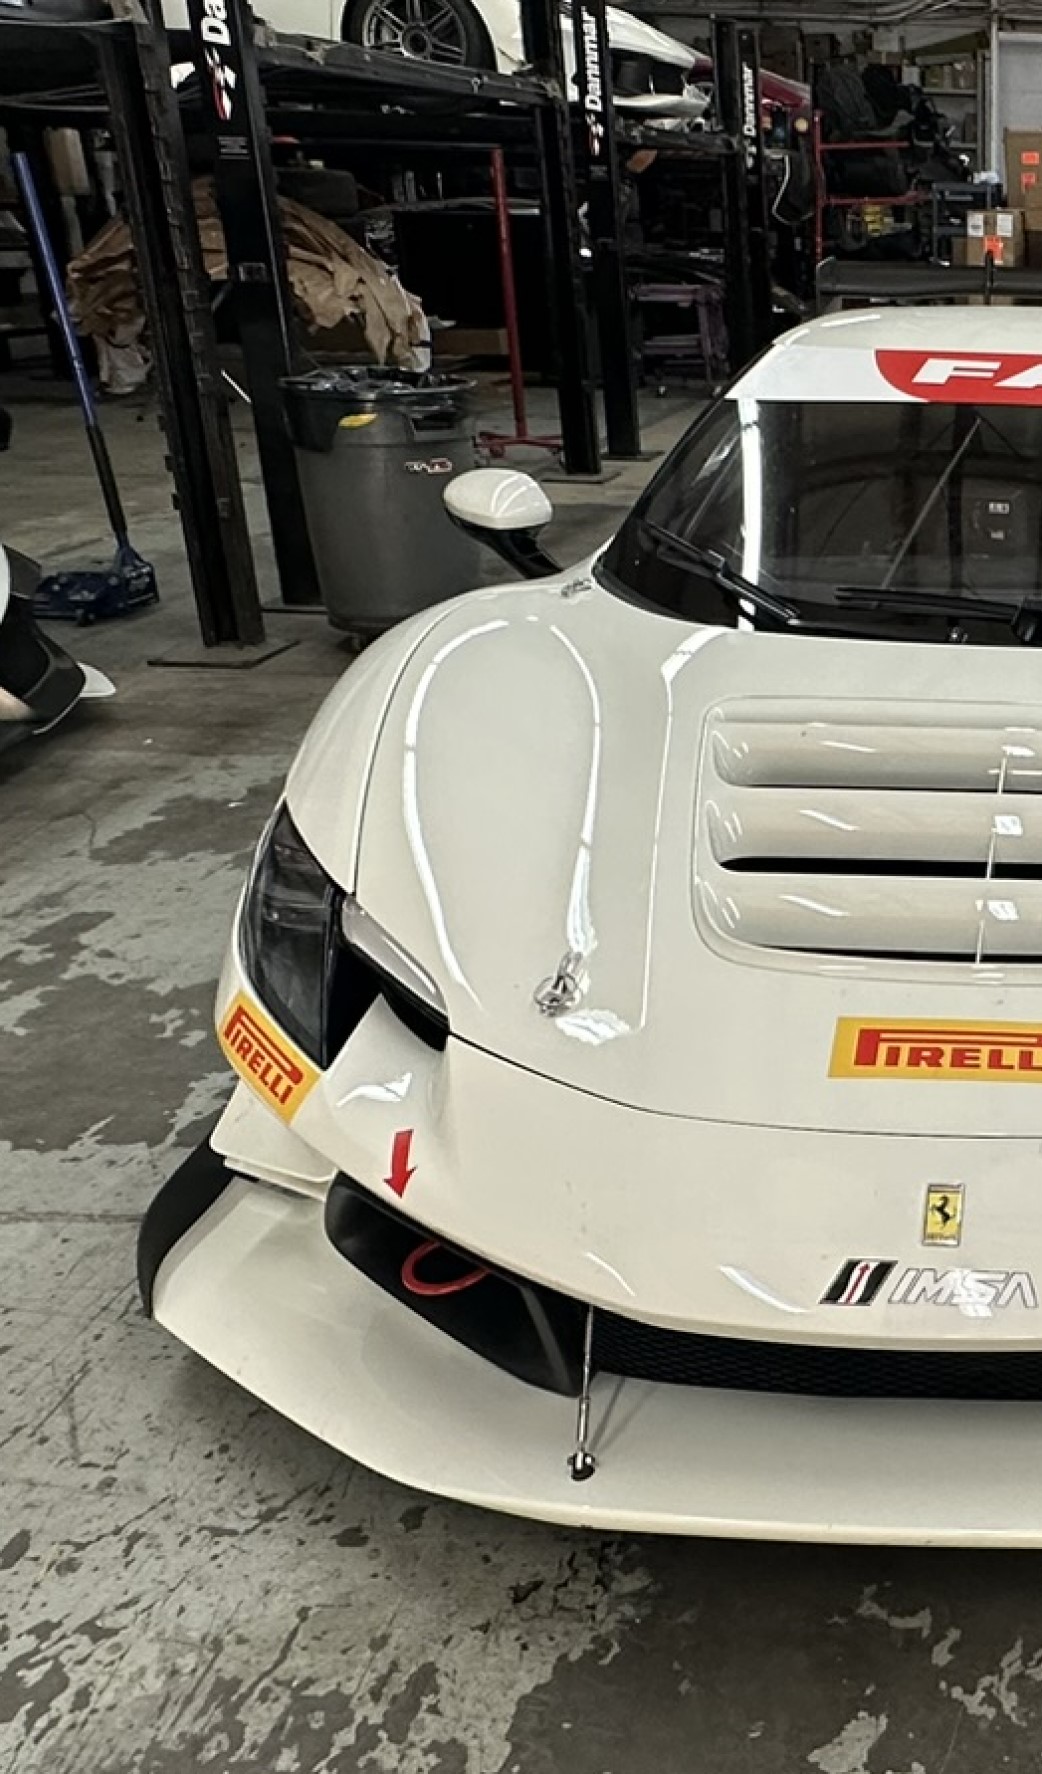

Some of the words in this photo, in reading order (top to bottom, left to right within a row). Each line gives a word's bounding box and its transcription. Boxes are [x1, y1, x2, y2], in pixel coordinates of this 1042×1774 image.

[580, 5, 603, 112] Dannmar
[742, 61, 757, 137] Dannmar
[224, 1004, 304, 1105] PIRELLI
[887, 1267, 1038, 1309] IMSA
